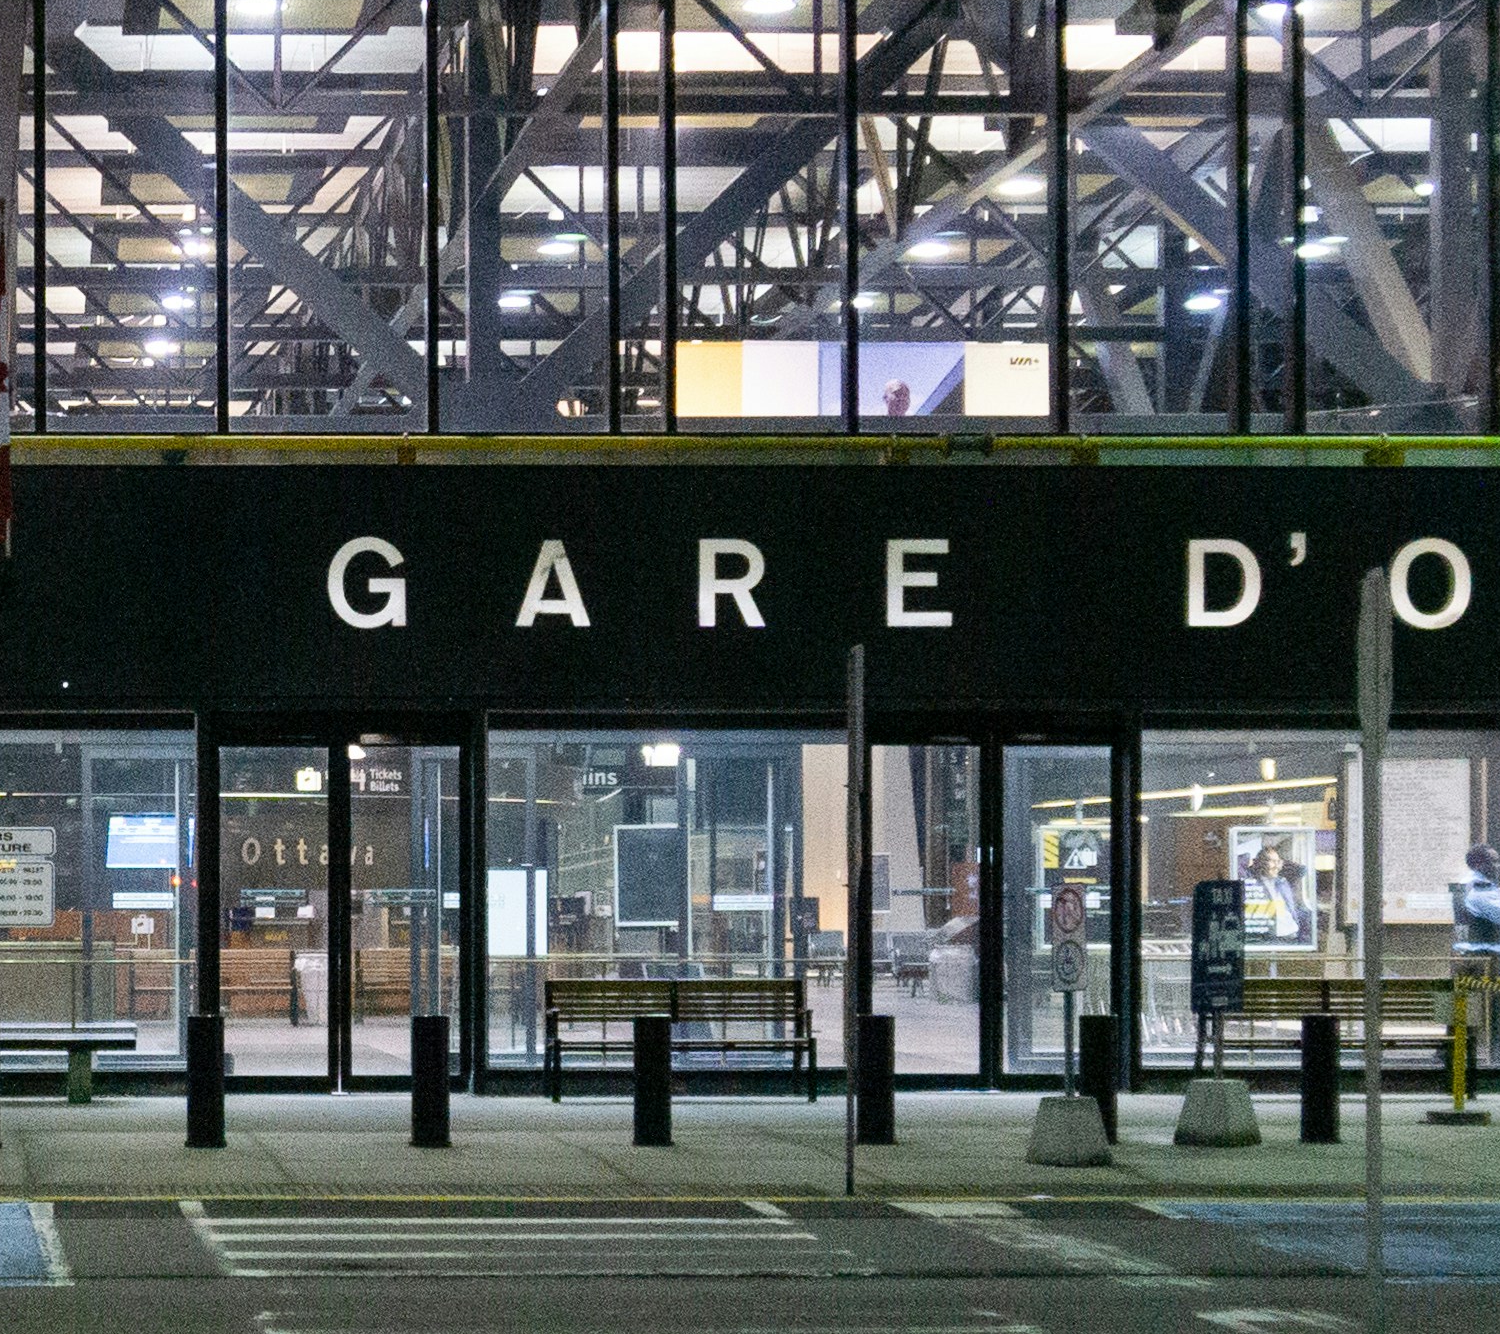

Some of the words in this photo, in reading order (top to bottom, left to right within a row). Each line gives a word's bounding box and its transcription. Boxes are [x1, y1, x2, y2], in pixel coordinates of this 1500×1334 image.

[327, 536, 954, 630] GARE
[370, 768, 402, 780] Tickets
[370, 780, 400, 792] Billets
